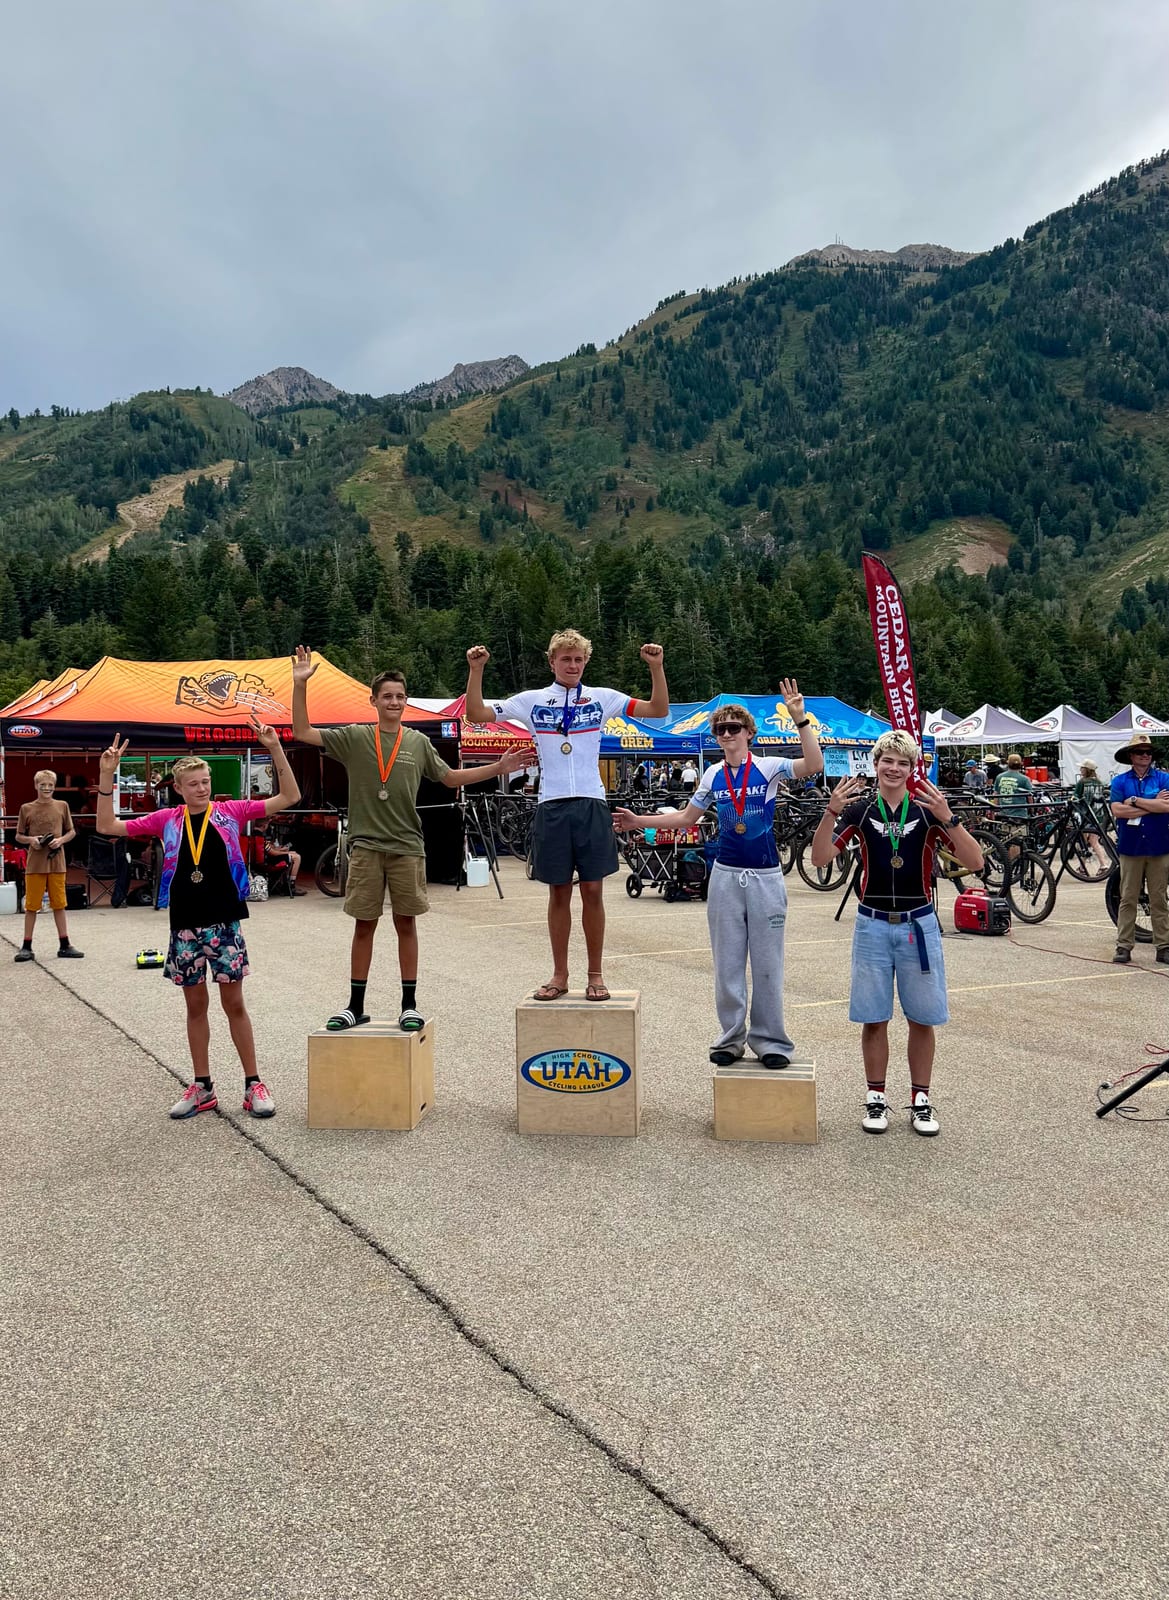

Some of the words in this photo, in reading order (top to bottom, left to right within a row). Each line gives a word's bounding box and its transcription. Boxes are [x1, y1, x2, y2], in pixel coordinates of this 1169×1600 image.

[875, 584, 896, 684] MOUNTAIN
[889, 687, 907, 728] BIKE
[885, 584, 909, 673] CEDAR
[901, 677, 925, 775] VALL
[461, 739, 511, 747] MOUNTAIN
[511, 740, 536, 748] VIEW
[621, 737, 655, 749] OREM
[757, 736, 784, 745] OREM
[786, 736, 836, 745] MOAIN
[713, 784, 767, 799] WESTAKE
[573, 1052, 601, 1061] SCHOOL
[540, 1061, 611, 1082] UTAH
[548, 1081, 577, 1090] CYCLING
[579, 1081, 605, 1090] LEAGUE
